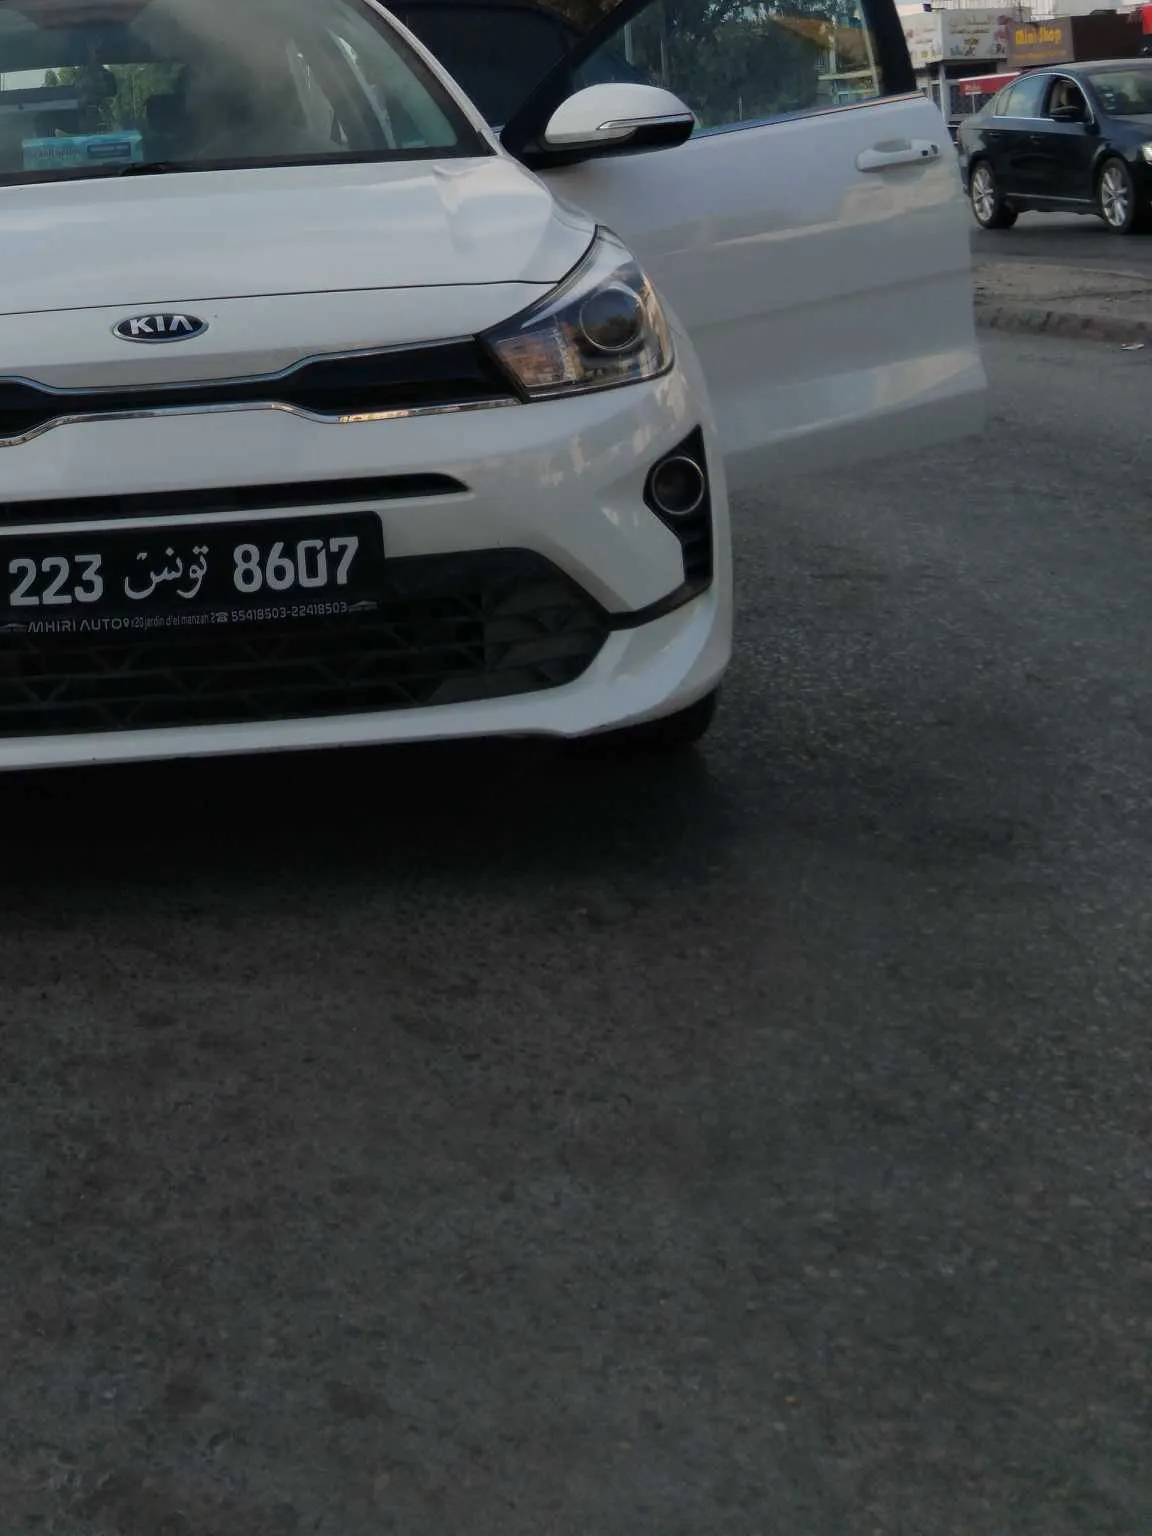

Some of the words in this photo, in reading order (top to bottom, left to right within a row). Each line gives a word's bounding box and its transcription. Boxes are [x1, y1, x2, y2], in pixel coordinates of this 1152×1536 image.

[129, 315, 194, 335] KIA
[9, 554, 104, 606] 223
[124, 545, 209, 600] تونس
[233, 536, 359, 593] 8607
[27, 618, 76, 633] MHIRI
[79, 618, 122, 631] AUTO
